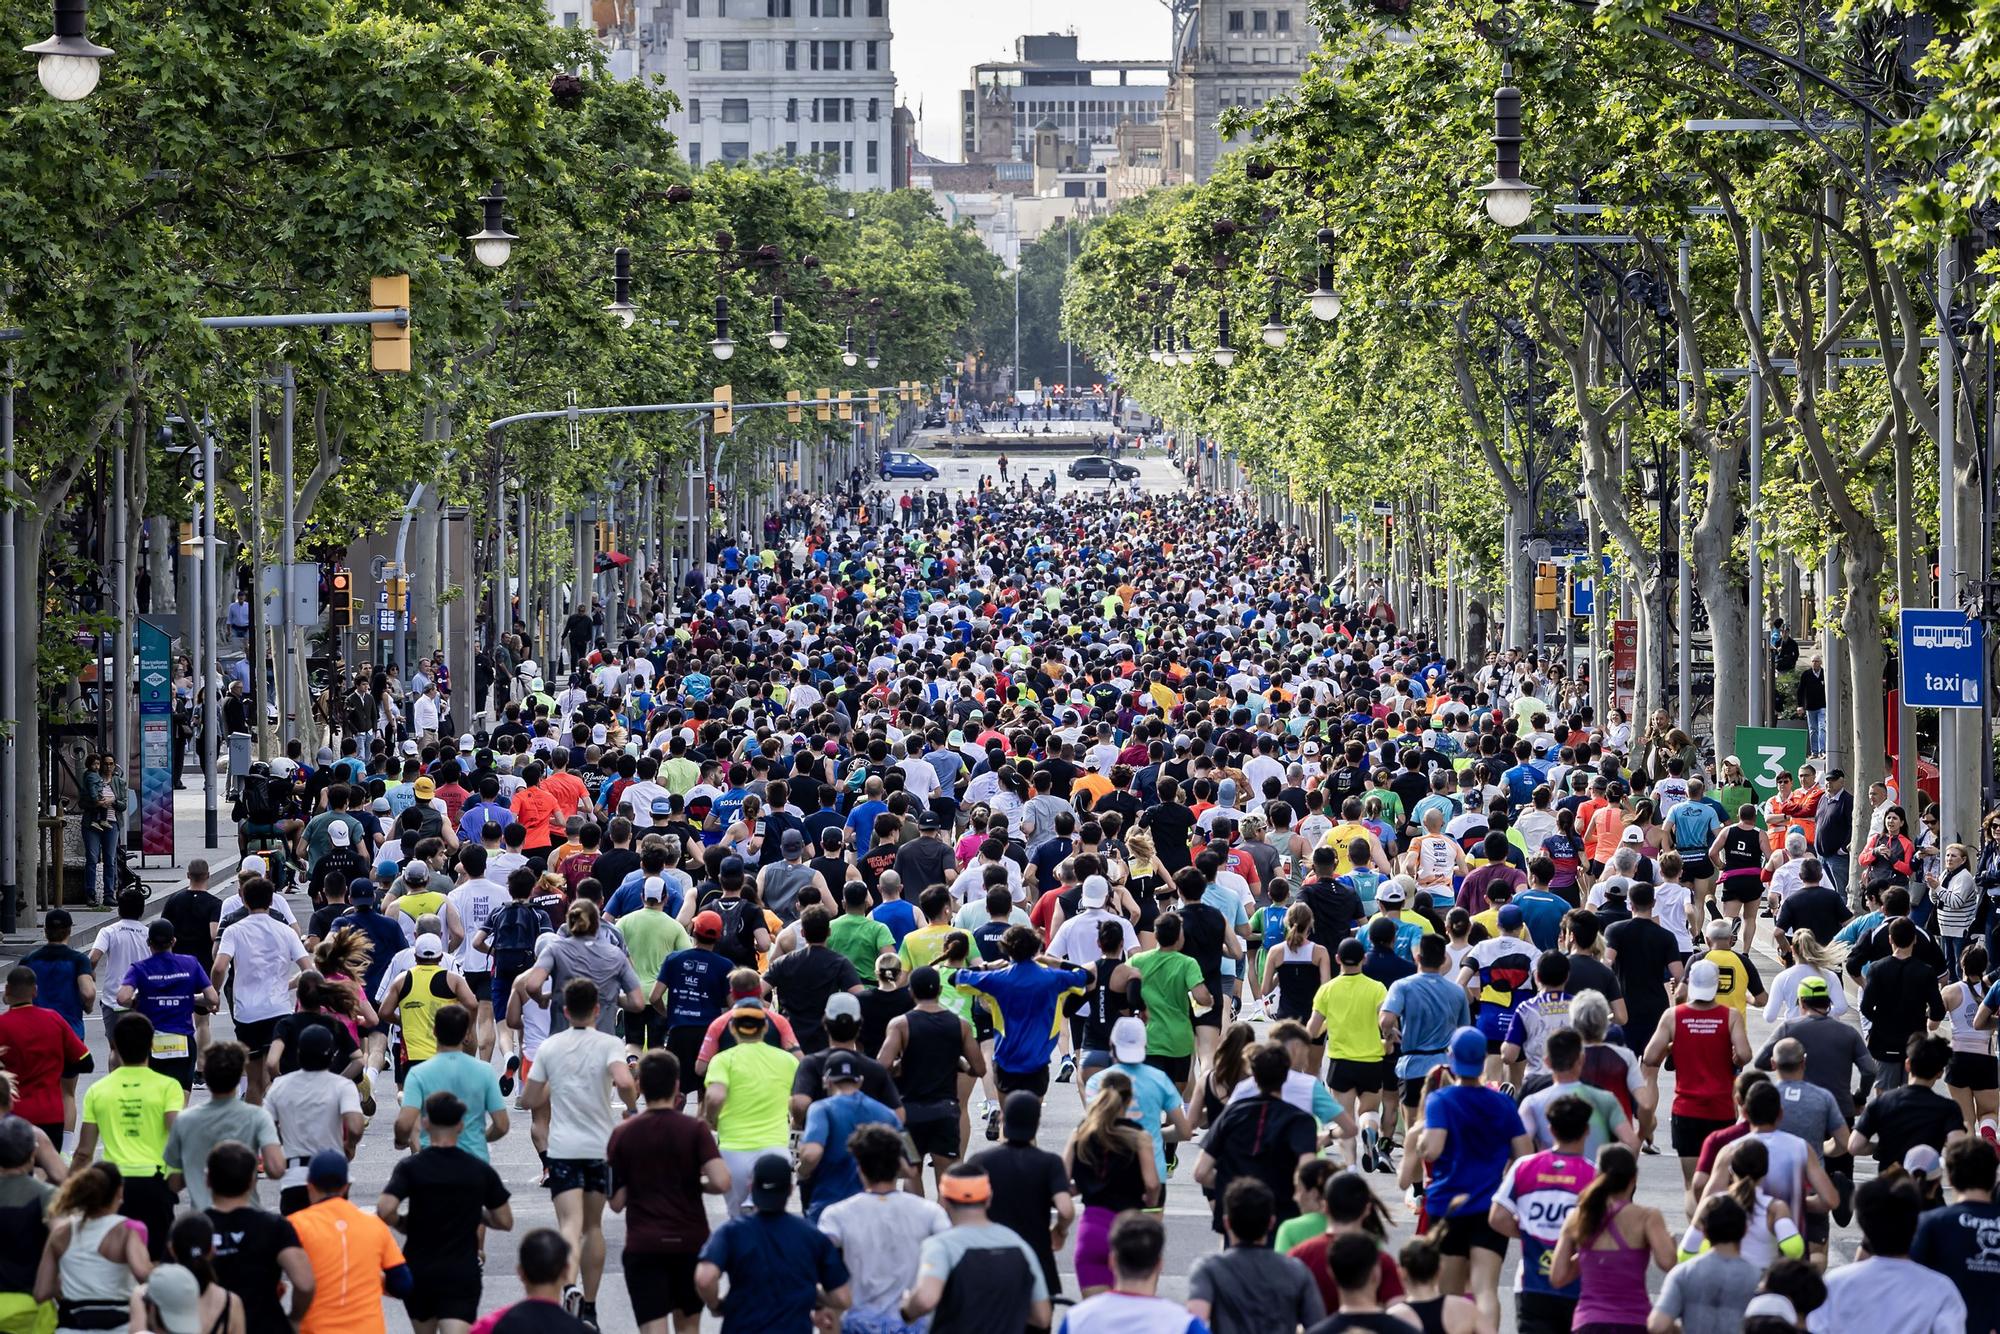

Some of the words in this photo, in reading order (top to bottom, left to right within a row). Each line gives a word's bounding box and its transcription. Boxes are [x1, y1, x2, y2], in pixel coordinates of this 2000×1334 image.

[381, 592, 388, 602] P
[1925, 672, 1959, 691] taxi
[1754, 745, 1786, 788] 3
[727, 808, 741, 824] 4
